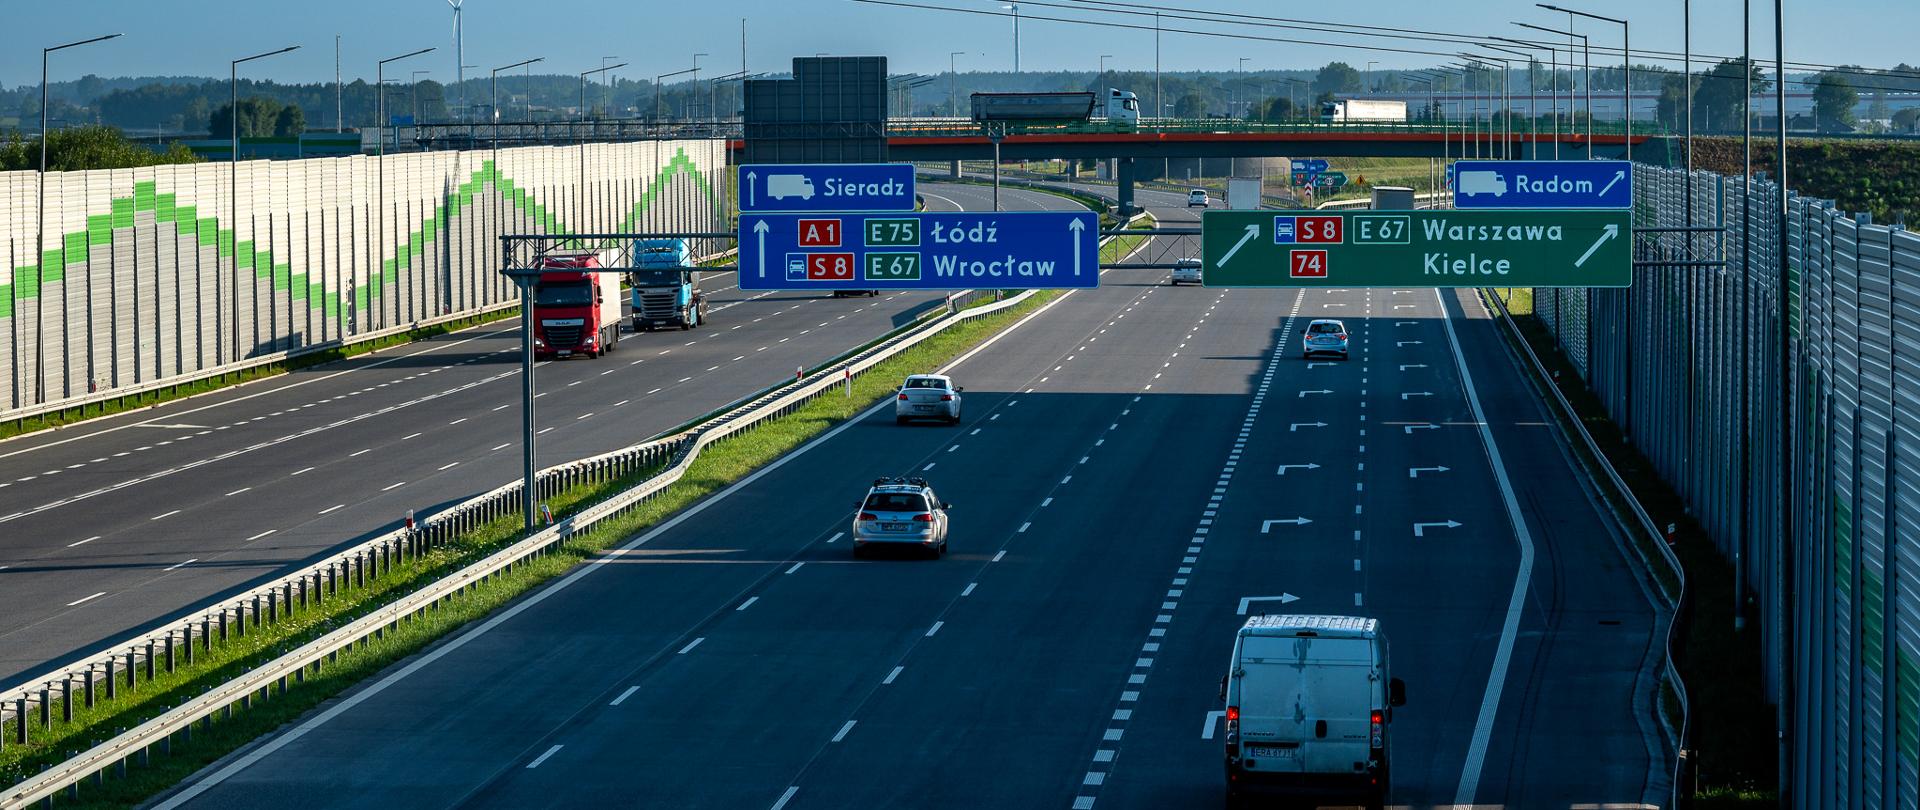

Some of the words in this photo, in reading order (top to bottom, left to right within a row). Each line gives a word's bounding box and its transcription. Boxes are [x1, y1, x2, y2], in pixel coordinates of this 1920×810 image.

[823, 177, 904, 197] Sieradz
[1516, 174, 1593, 193] Radom
[930, 220, 997, 244] Łódź
[1422, 219, 1563, 241] Warszawa
[932, 254, 1056, 277] Wrocław
[1296, 254, 1321, 273] 74
[1424, 252, 1510, 275] Kielce
